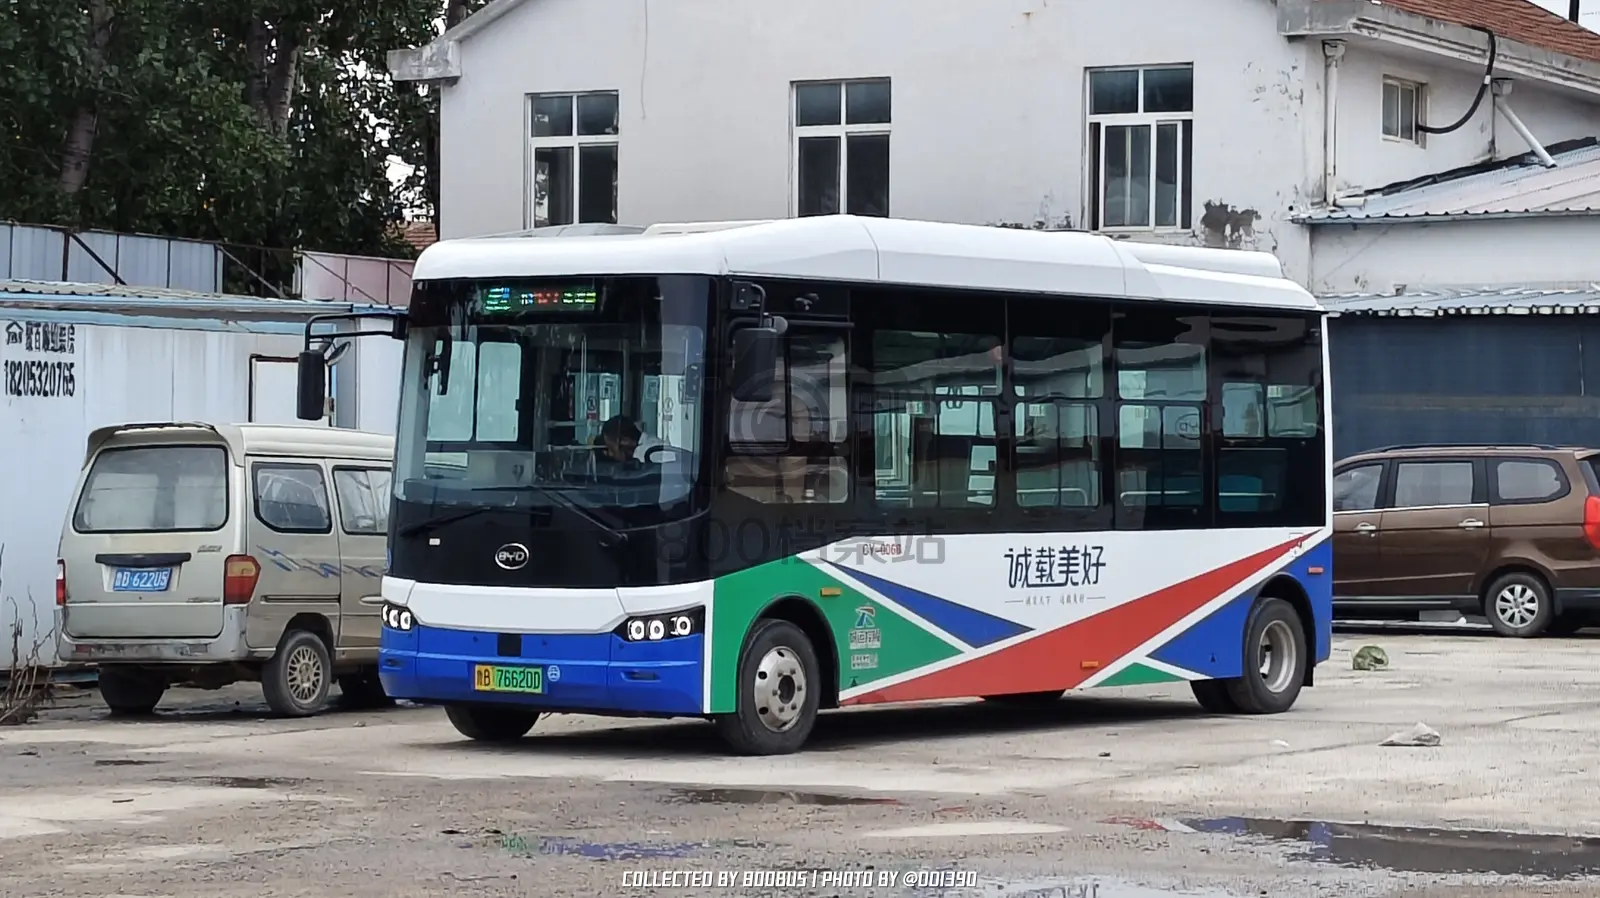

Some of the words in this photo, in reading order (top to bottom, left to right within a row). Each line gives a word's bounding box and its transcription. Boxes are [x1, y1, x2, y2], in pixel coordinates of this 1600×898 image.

[4, 360, 75, 397] 18205320765
[1004, 544, 1106, 588] 诚载美好
